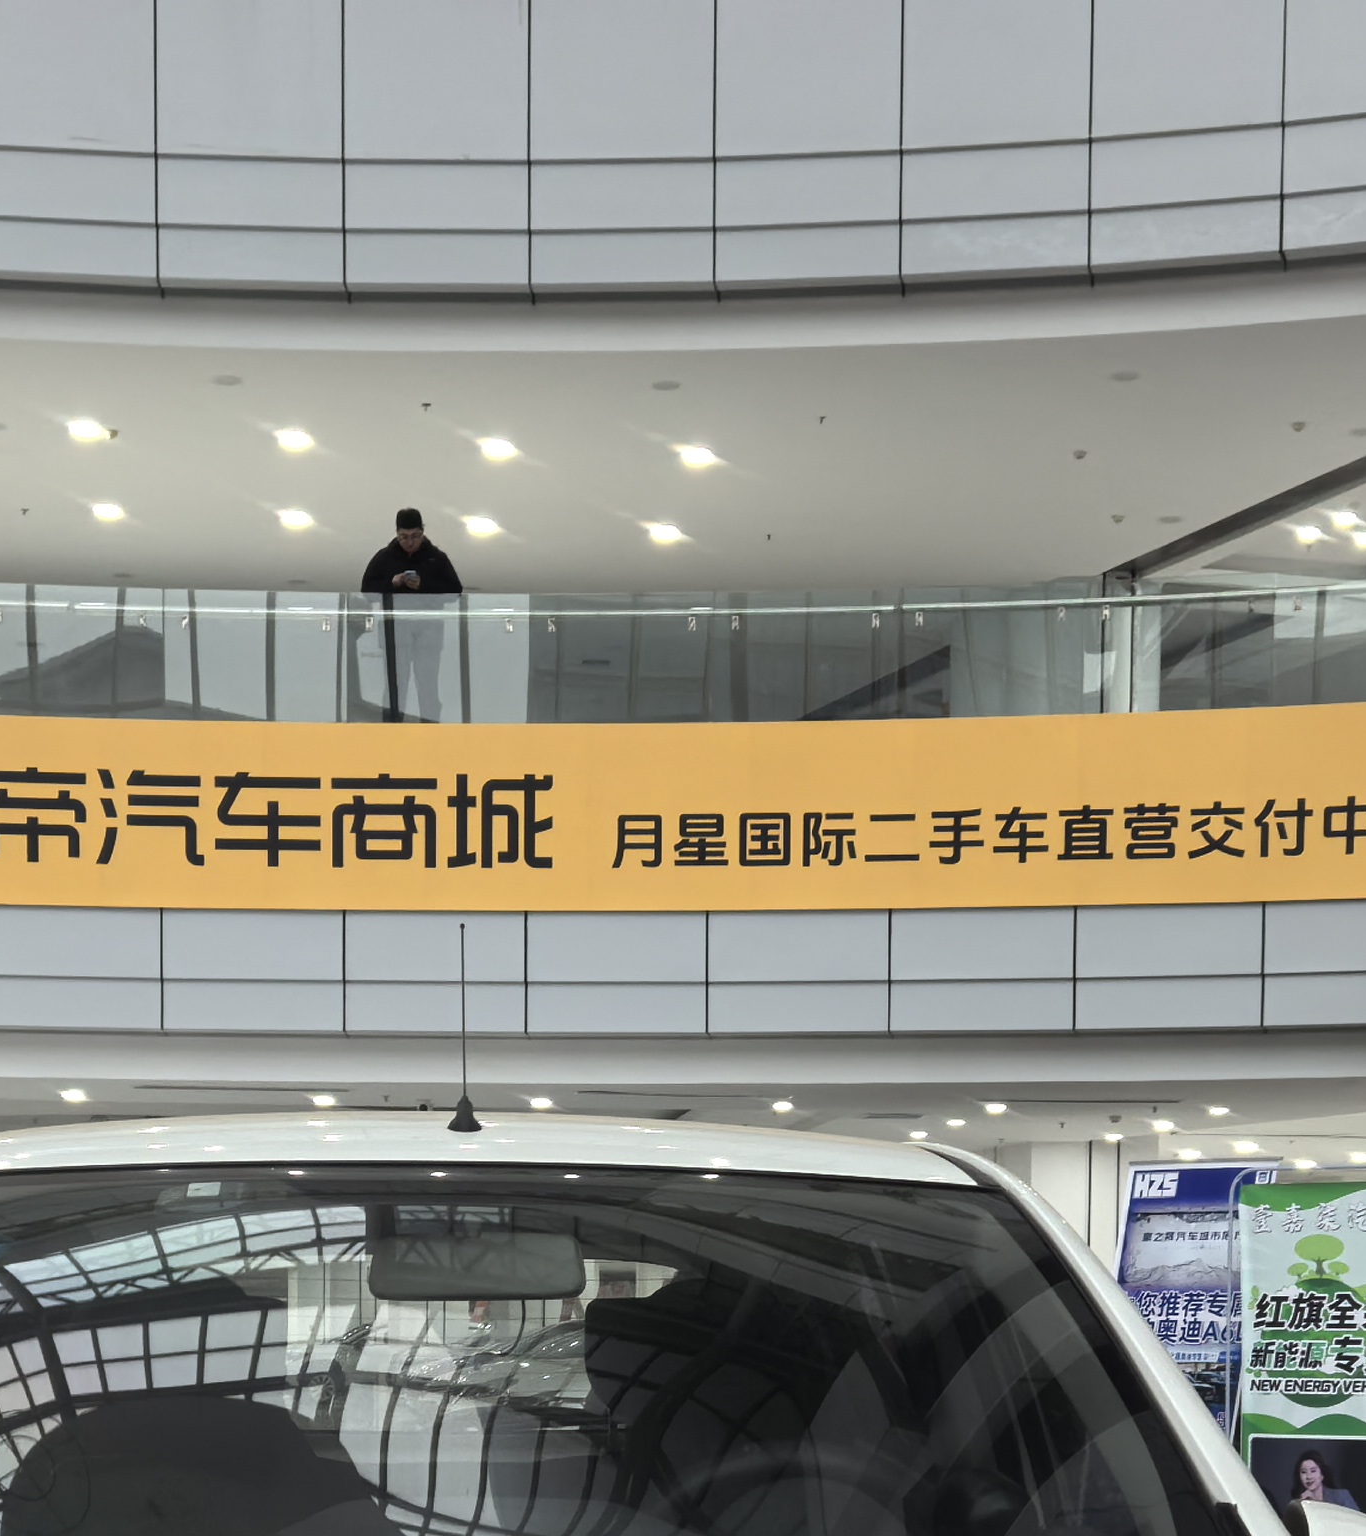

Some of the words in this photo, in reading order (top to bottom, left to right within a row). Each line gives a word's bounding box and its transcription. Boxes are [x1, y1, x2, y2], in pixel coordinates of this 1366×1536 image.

[1133, 1171, 1179, 1198] HZS
[1250, 1379, 1282, 1392] NEW
[1285, 1379, 1340, 1394] ENERGY
